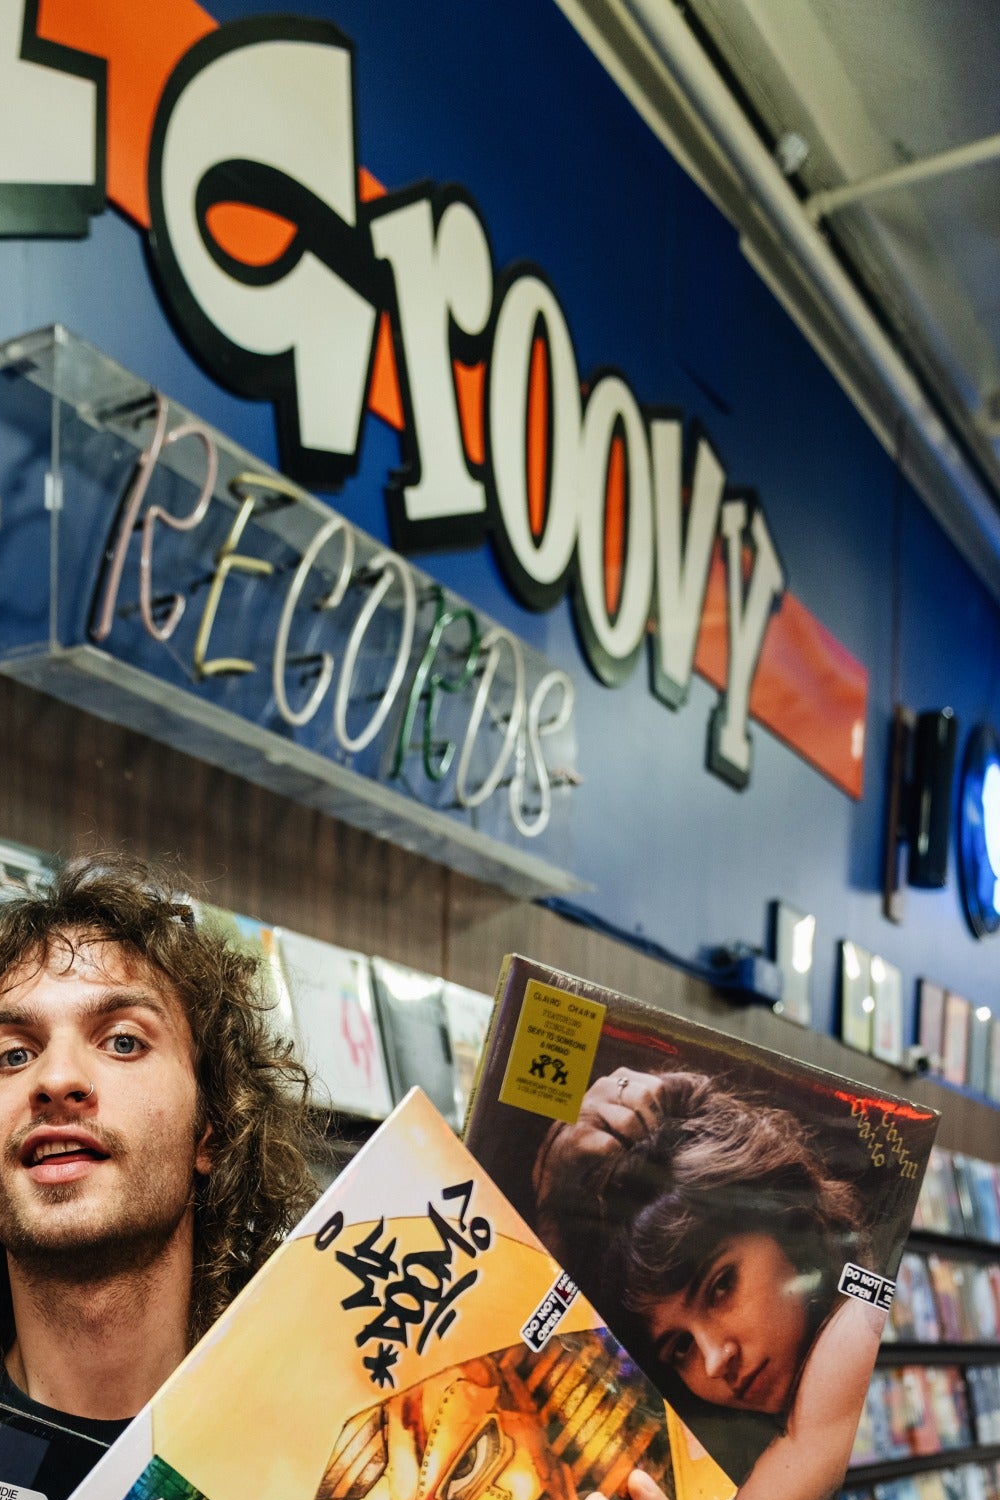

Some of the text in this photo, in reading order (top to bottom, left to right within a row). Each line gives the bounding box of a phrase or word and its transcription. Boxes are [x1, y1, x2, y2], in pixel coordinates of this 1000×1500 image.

[160, 38, 787, 773] Groovy
[92, 396, 575, 838] RECORDS
[533, 992, 560, 1008] CLAIRO
[845, 1267, 880, 1290] DO NOT
[846, 1283, 873, 1300] OPEN
[523, 1293, 558, 1339] DO NOT
[537, 1308, 562, 1341] OPEN
